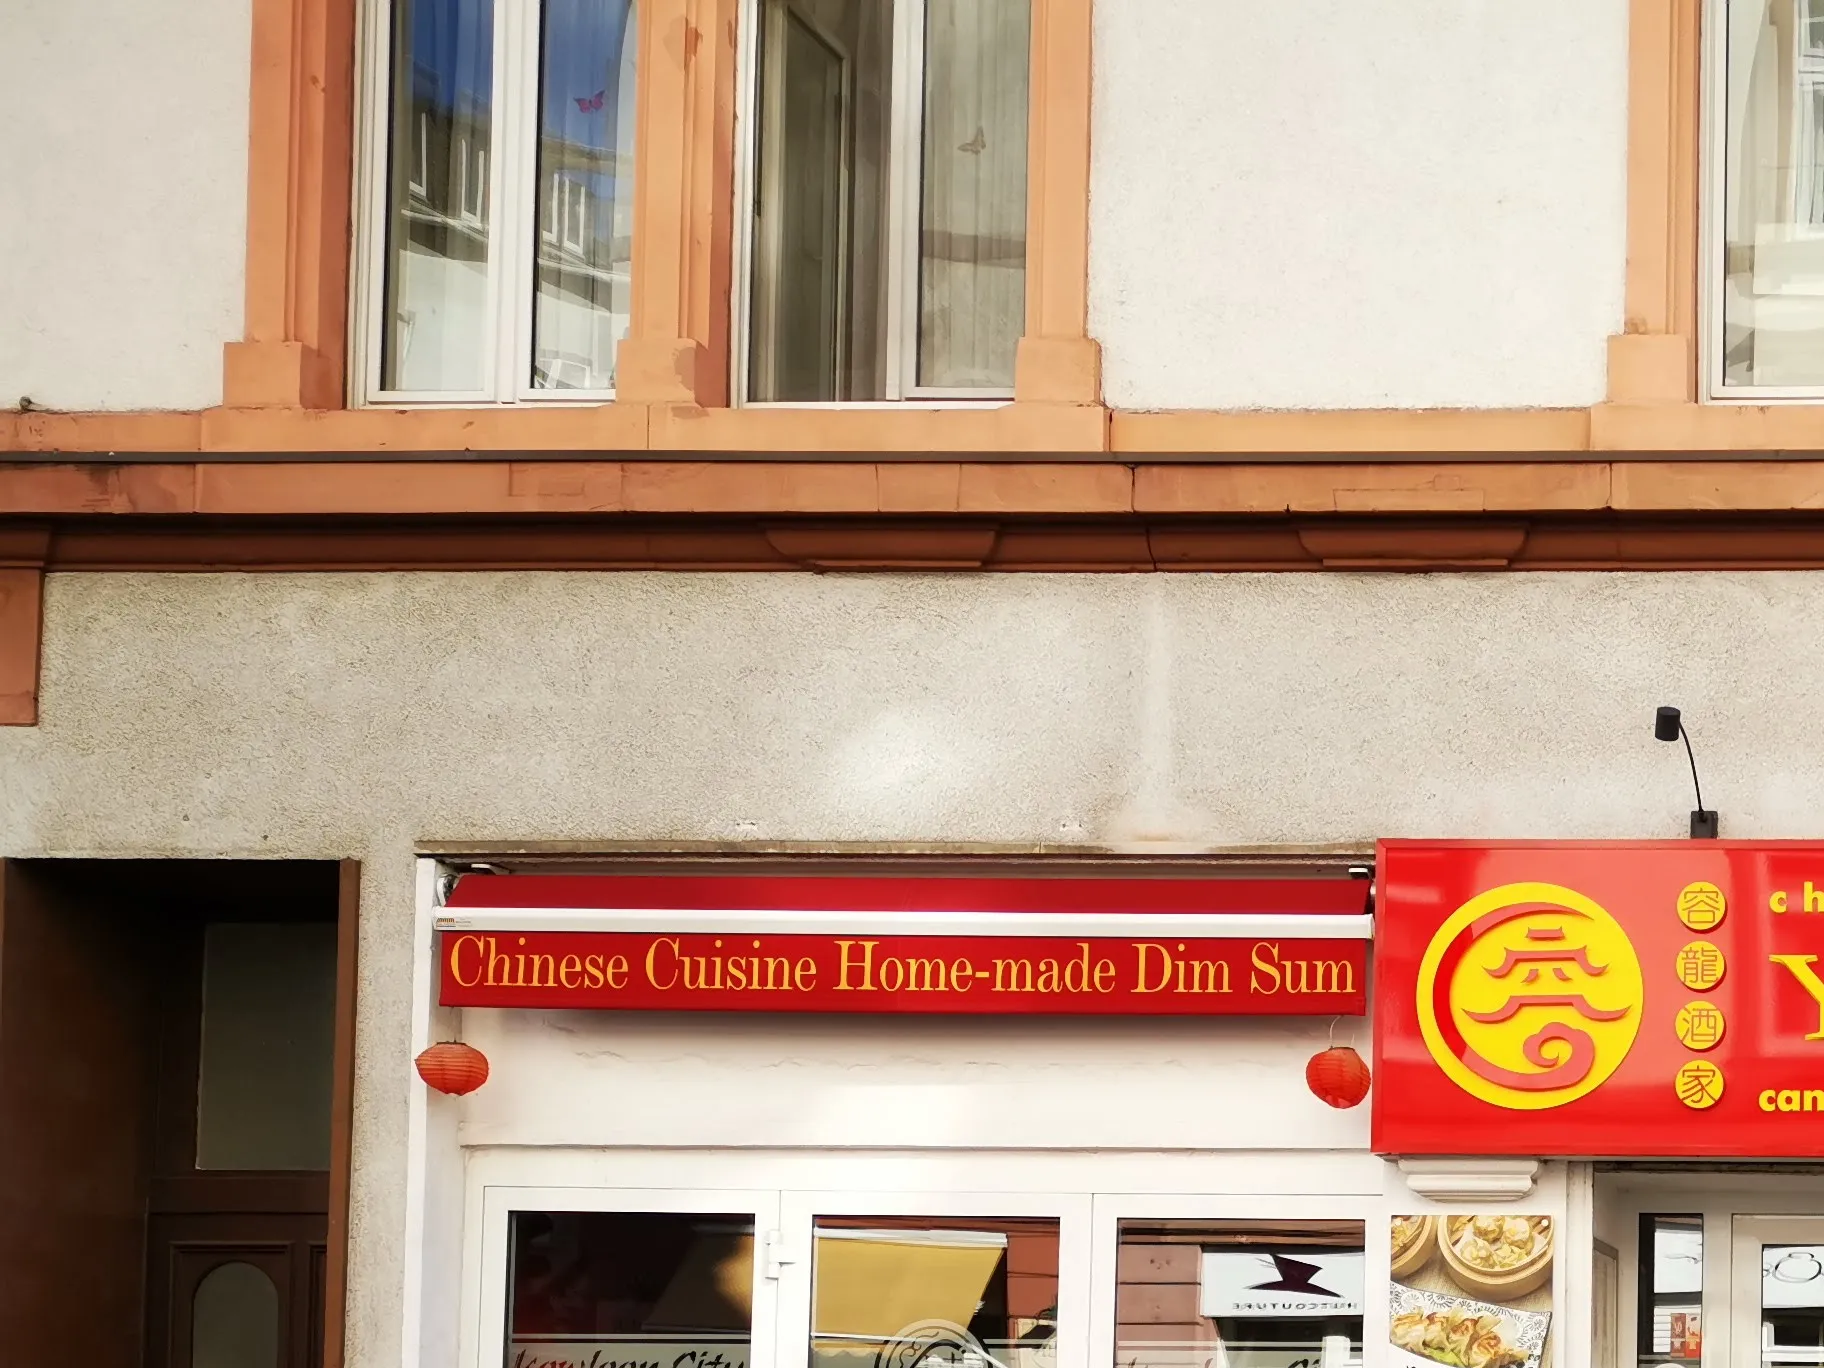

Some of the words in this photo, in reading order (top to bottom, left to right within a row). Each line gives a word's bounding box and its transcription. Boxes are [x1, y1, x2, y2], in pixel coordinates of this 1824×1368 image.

[450, 935, 628, 988] Chinese
[645, 937, 816, 990] Cuisine
[833, 940, 1116, 994] Home-made
[1131, 942, 1231, 994] Dim
[1250, 943, 1356, 995] Sum
[1680, 884, 1722, 1106] 容龍酒家
